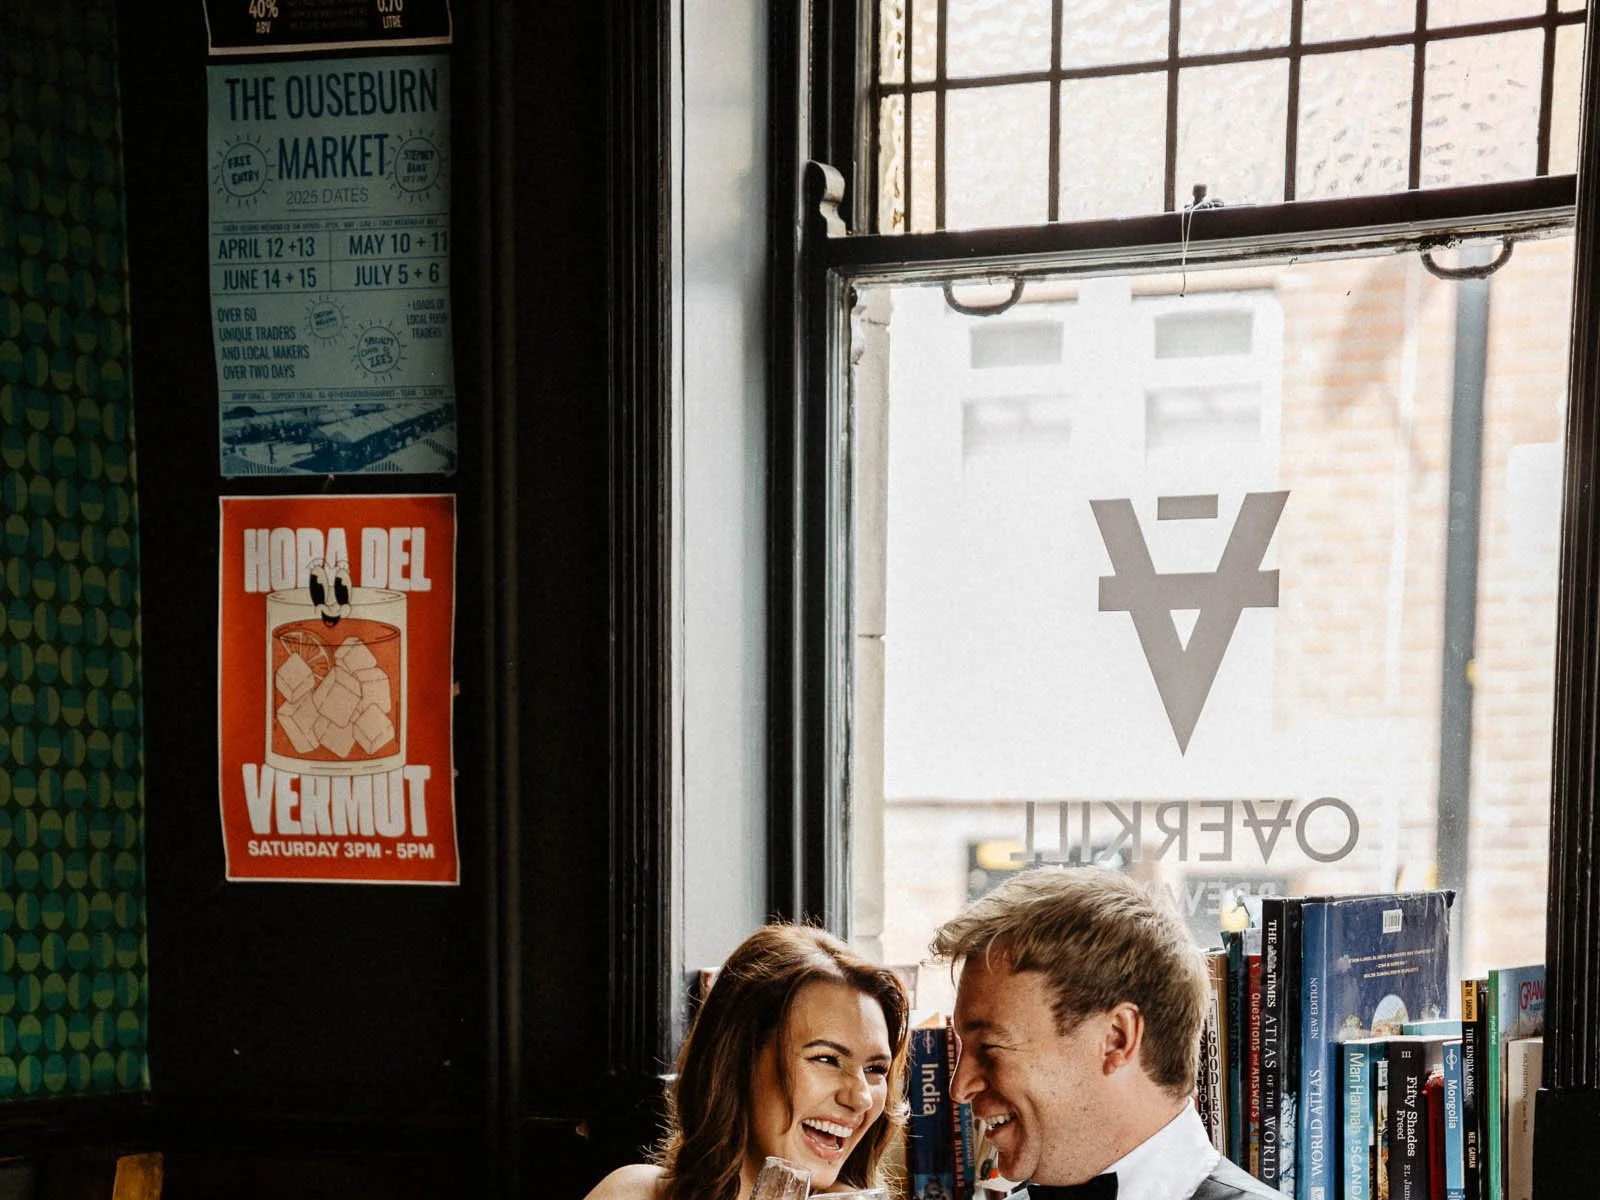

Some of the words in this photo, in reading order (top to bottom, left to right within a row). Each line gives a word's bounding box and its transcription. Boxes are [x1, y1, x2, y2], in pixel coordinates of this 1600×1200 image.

[249, 0, 279, 18] 40%
[256, 21, 271, 34] ABV
[383, 16, 402, 29] LITRE
[225, 76, 277, 121] THE
[286, 67, 438, 120] OUSEBURN
[277, 133, 389, 180] MARKET
[286, 189, 318, 205] 2025
[322, 187, 369, 204] DATES
[218, 238, 261, 259] APRIL
[267, 238, 284, 258] 12
[349, 234, 385, 255] MAY
[391, 233, 410, 254] 10
[431, 231, 448, 252] 11
[222, 269, 258, 290] JUNE
[263, 268, 280, 289] 14
[300, 267, 317, 288] 15
[354, 264, 392, 287] JULY
[398, 264, 409, 284] 5
[428, 263, 440, 283] 6
[217, 308, 242, 323] OVER
[244, 307, 257, 321] 60
[406, 313, 428, 325] LOCAL
[219, 327, 256, 343] UNIQUE
[256, 326, 296, 340] TRADERS
[412, 327, 442, 340] TRADERS
[221, 346, 241, 360] AND
[242, 345, 271, 360] LOCAL
[272, 344, 310, 359] MAKERS
[223, 365, 247, 380] OVER
[249, 364, 270, 379] TWO
[271, 363, 297, 378] DAYS
[361, 527, 431, 592] DEL
[242, 764, 431, 837] VERMUT
[247, 840, 340, 858] SATURDAY
[344, 841, 382, 858] 3PM
[396, 842, 435, 859] 5PM
[1266, 919, 1278, 944] THE
[1230, 971, 1240, 998] WEST
[1266, 972, 1277, 1008] TIMES
[1230, 1000, 1240, 1036] COAST
[1264, 1014, 1277, 1068] ATLAS
[1466, 1028, 1474, 1043] THE
[1231, 1038, 1240, 1070] STORY
[1466, 1045, 1474, 1073] KINDLY
[1208, 1031, 1220, 1126] GOODIES
[1350, 1052, 1364, 1082] Mari
[921, 1063, 941, 1116] India
[1266, 1074, 1274, 1087] OF
[1311, 1069, 1322, 1116] ATLAS
[1404, 1076, 1418, 1107] Fifty
[1466, 1076, 1475, 1097] ONES
[1265, 1091, 1274, 1110] THE
[1350, 1085, 1363, 1135] Hannah
[1448, 1079, 1458, 1129] Mongolia
[1396, 1109, 1406, 1140] Freed
[1407, 1111, 1418, 1157] Shades
[1263, 1116, 1276, 1179] WORLD
[1311, 1118, 1324, 1177] WORLD
[1468, 1131, 1476, 1144] NEIL
[1468, 1146, 1476, 1169] GAIMAN
